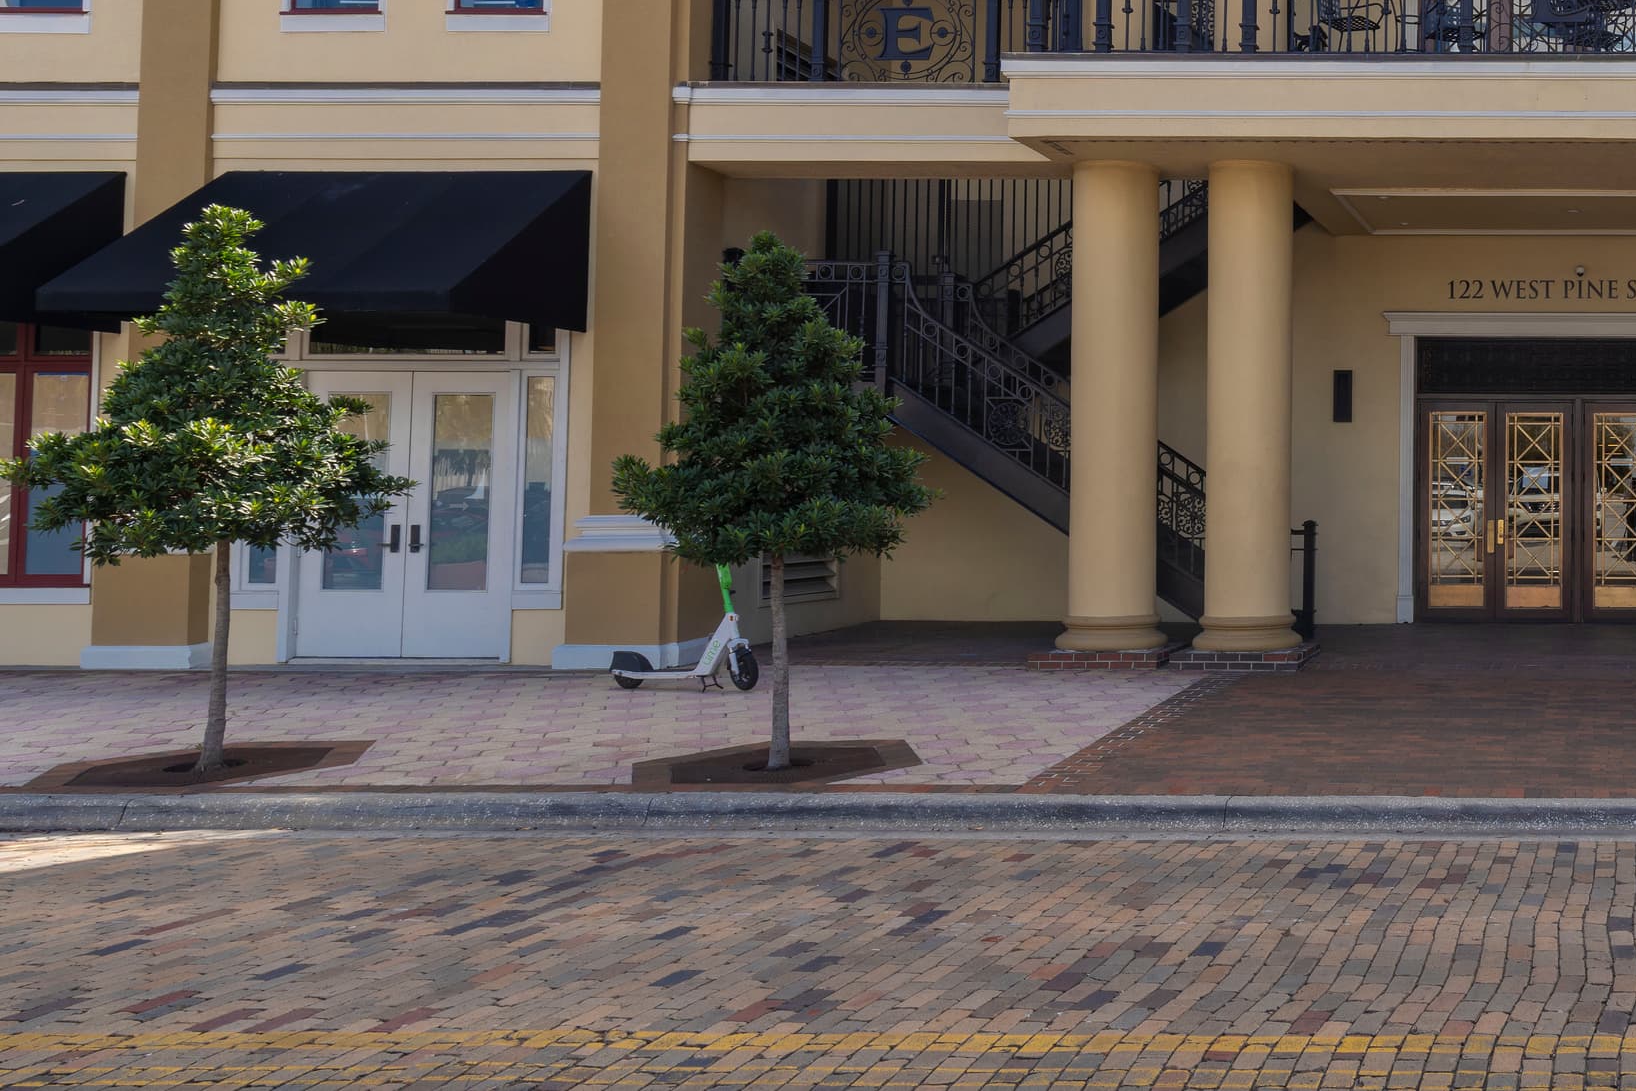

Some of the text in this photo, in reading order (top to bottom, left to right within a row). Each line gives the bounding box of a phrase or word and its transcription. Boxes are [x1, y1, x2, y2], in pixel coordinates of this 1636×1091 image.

[1447, 279, 1485, 300] 122
[1490, 279, 1555, 300] WEST
[1562, 279, 1619, 300] PINE
